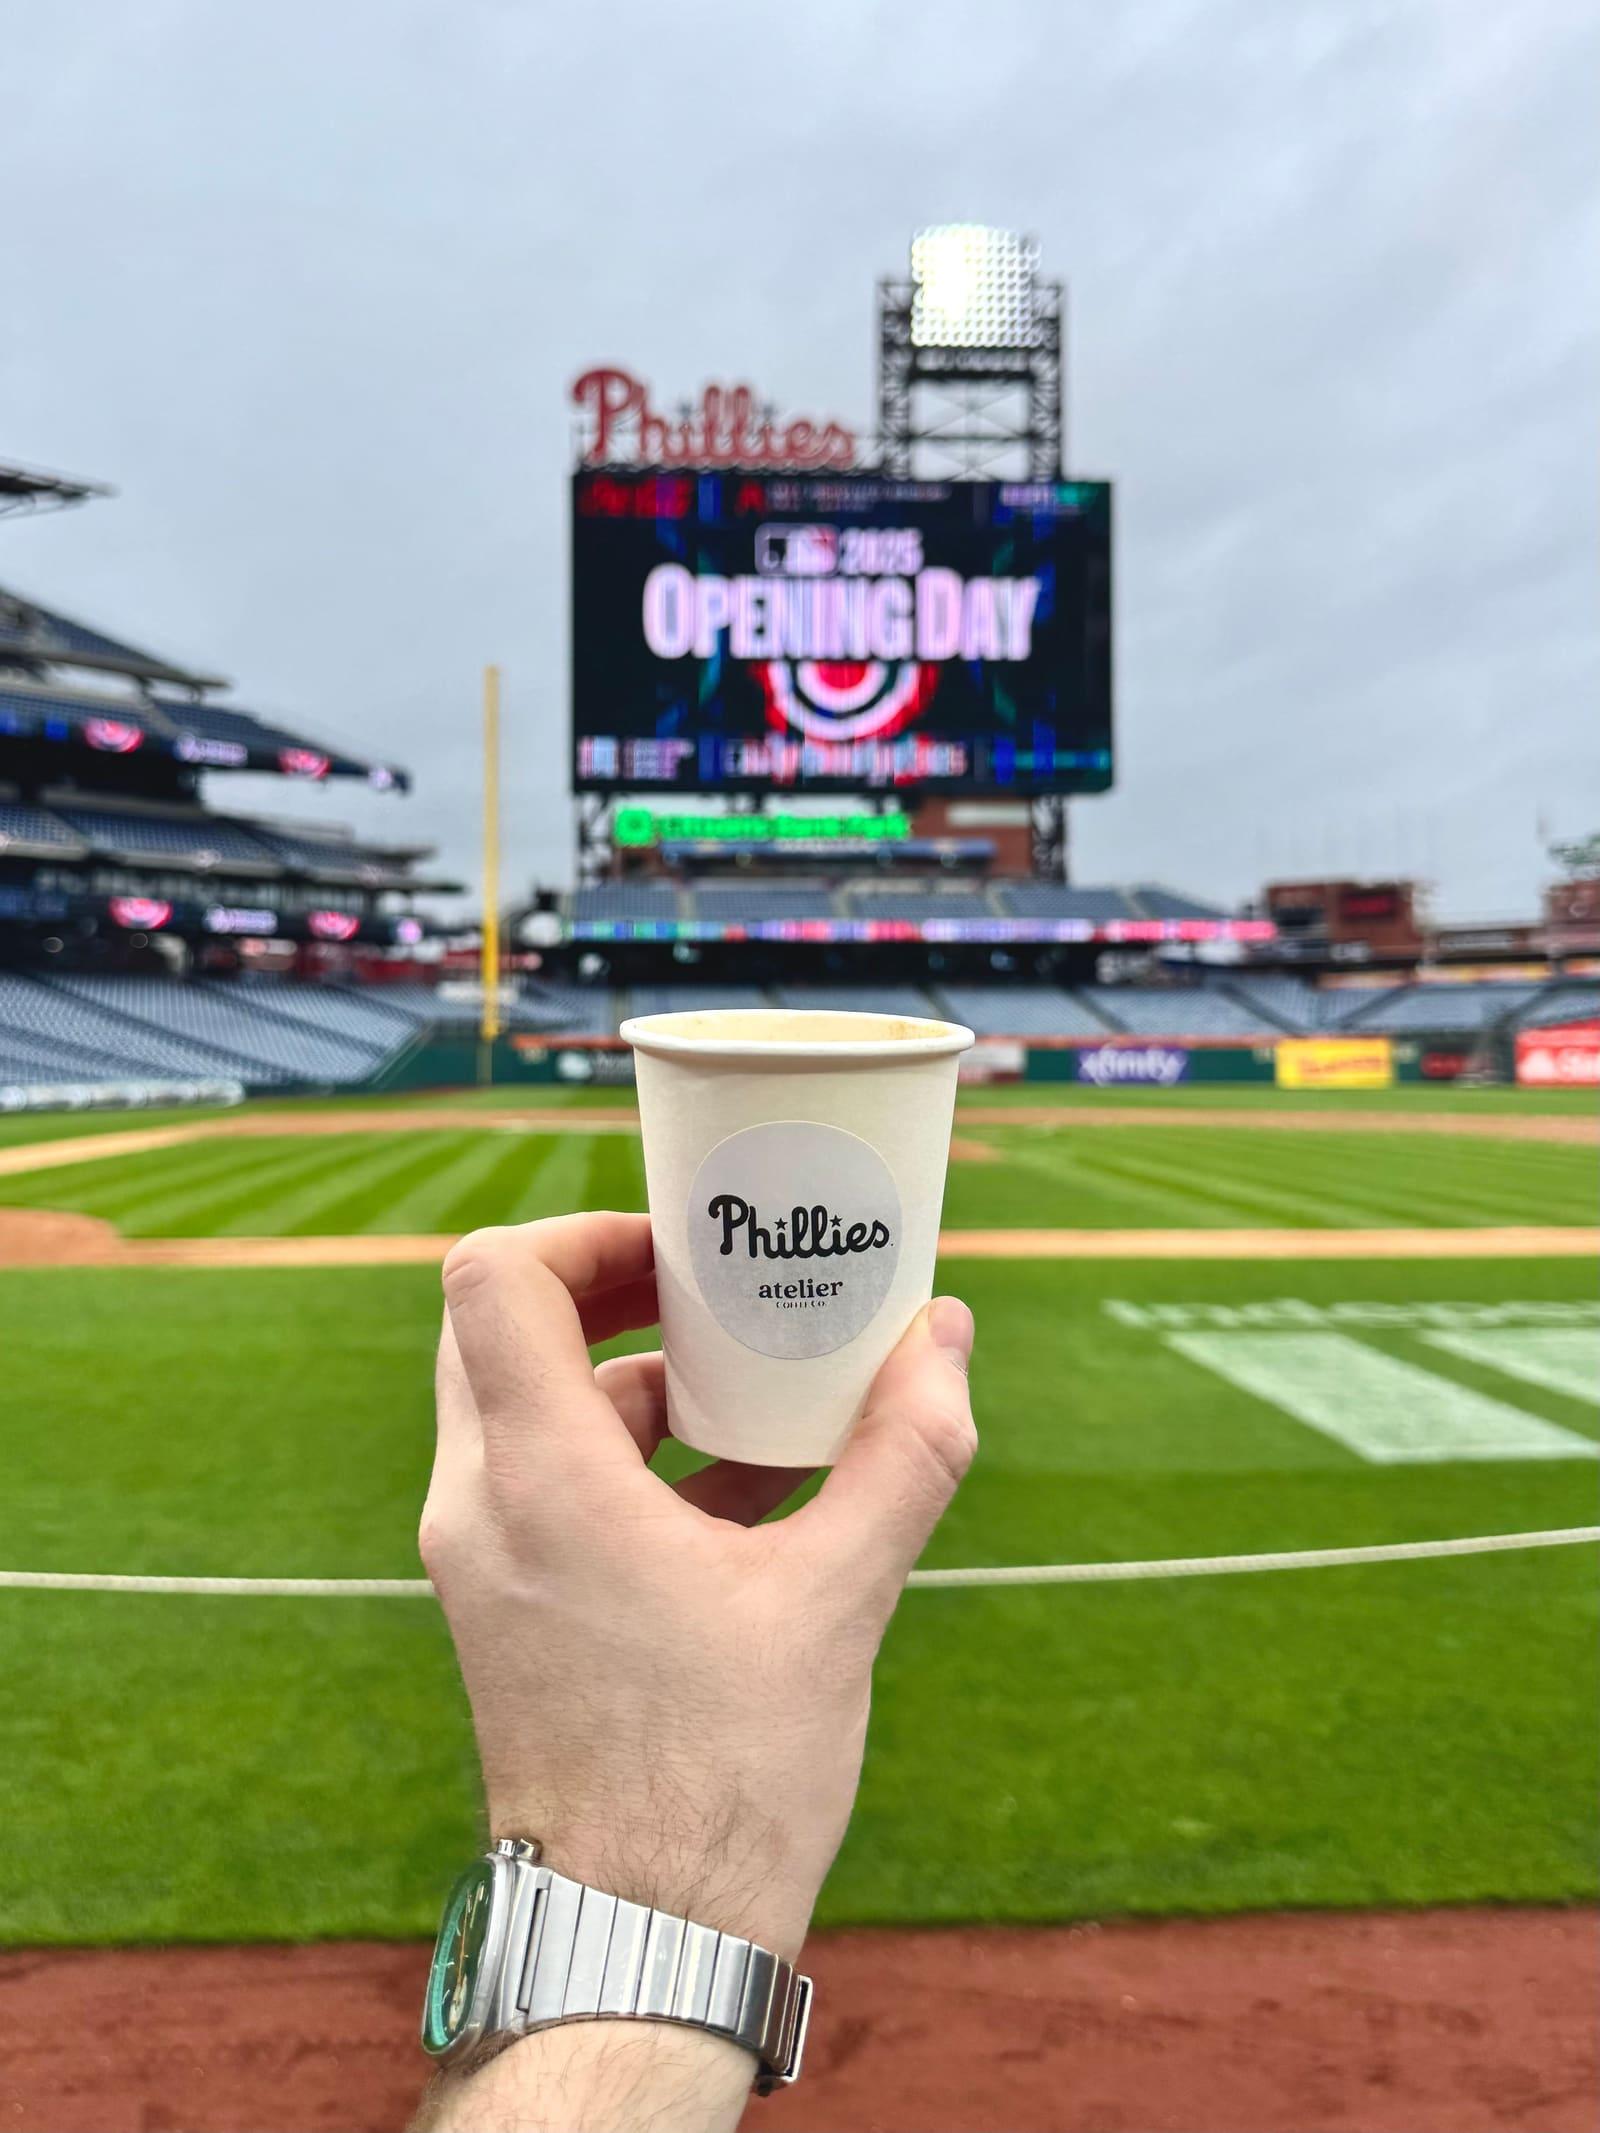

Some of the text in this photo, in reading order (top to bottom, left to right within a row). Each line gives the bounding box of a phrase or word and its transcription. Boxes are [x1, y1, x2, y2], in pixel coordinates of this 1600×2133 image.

[571, 366, 855, 469] Phillies
[643, 562, 1043, 660] OPENING DAY
[708, 1194, 891, 1259] Phillies
[759, 1278, 843, 1299] atelier
